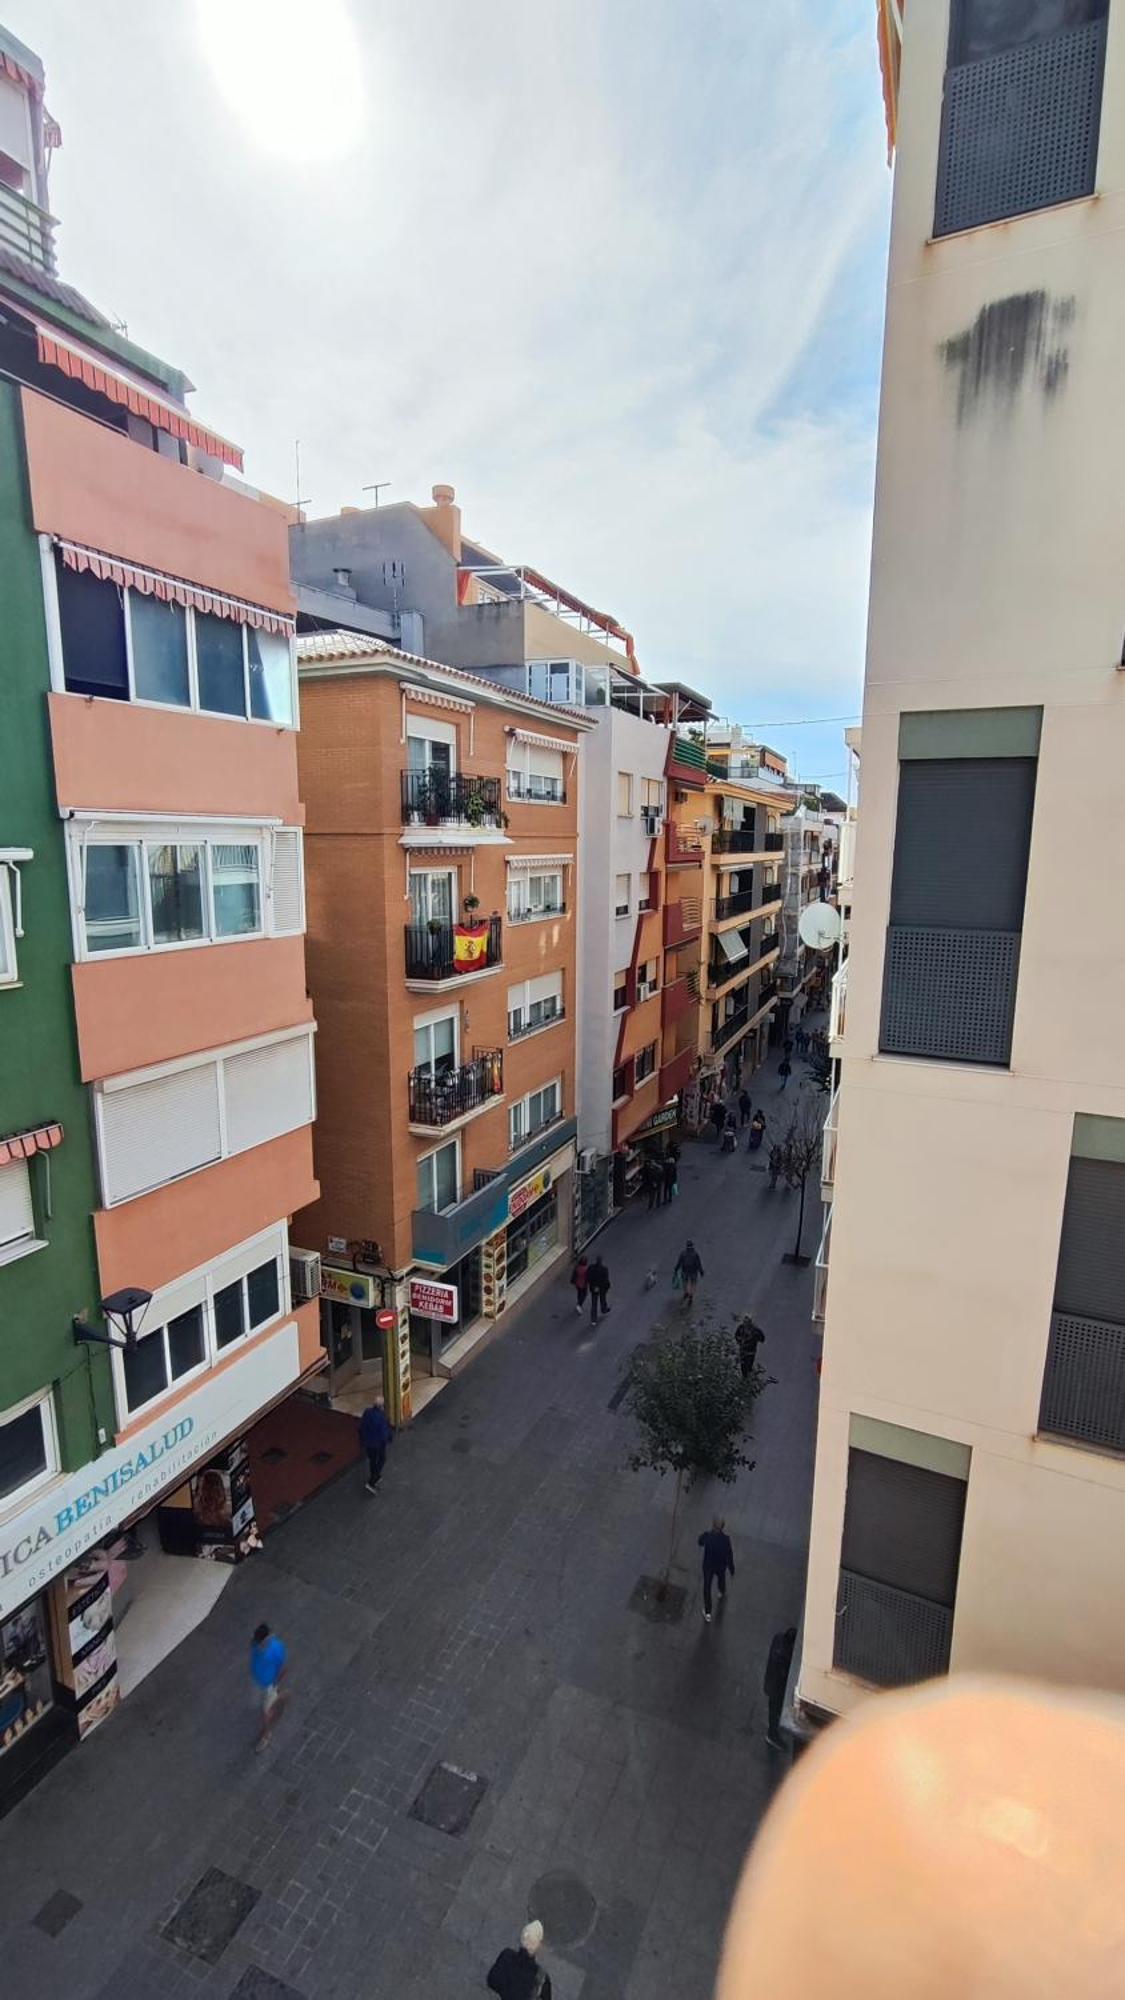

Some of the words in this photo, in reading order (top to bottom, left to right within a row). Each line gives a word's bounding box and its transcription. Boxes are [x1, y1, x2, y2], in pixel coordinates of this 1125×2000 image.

[414, 1284, 449, 1298] PIZZERIA
[418, 1300, 445, 1312] KEBAB
[54, 1417, 193, 1536] BENISALUD
